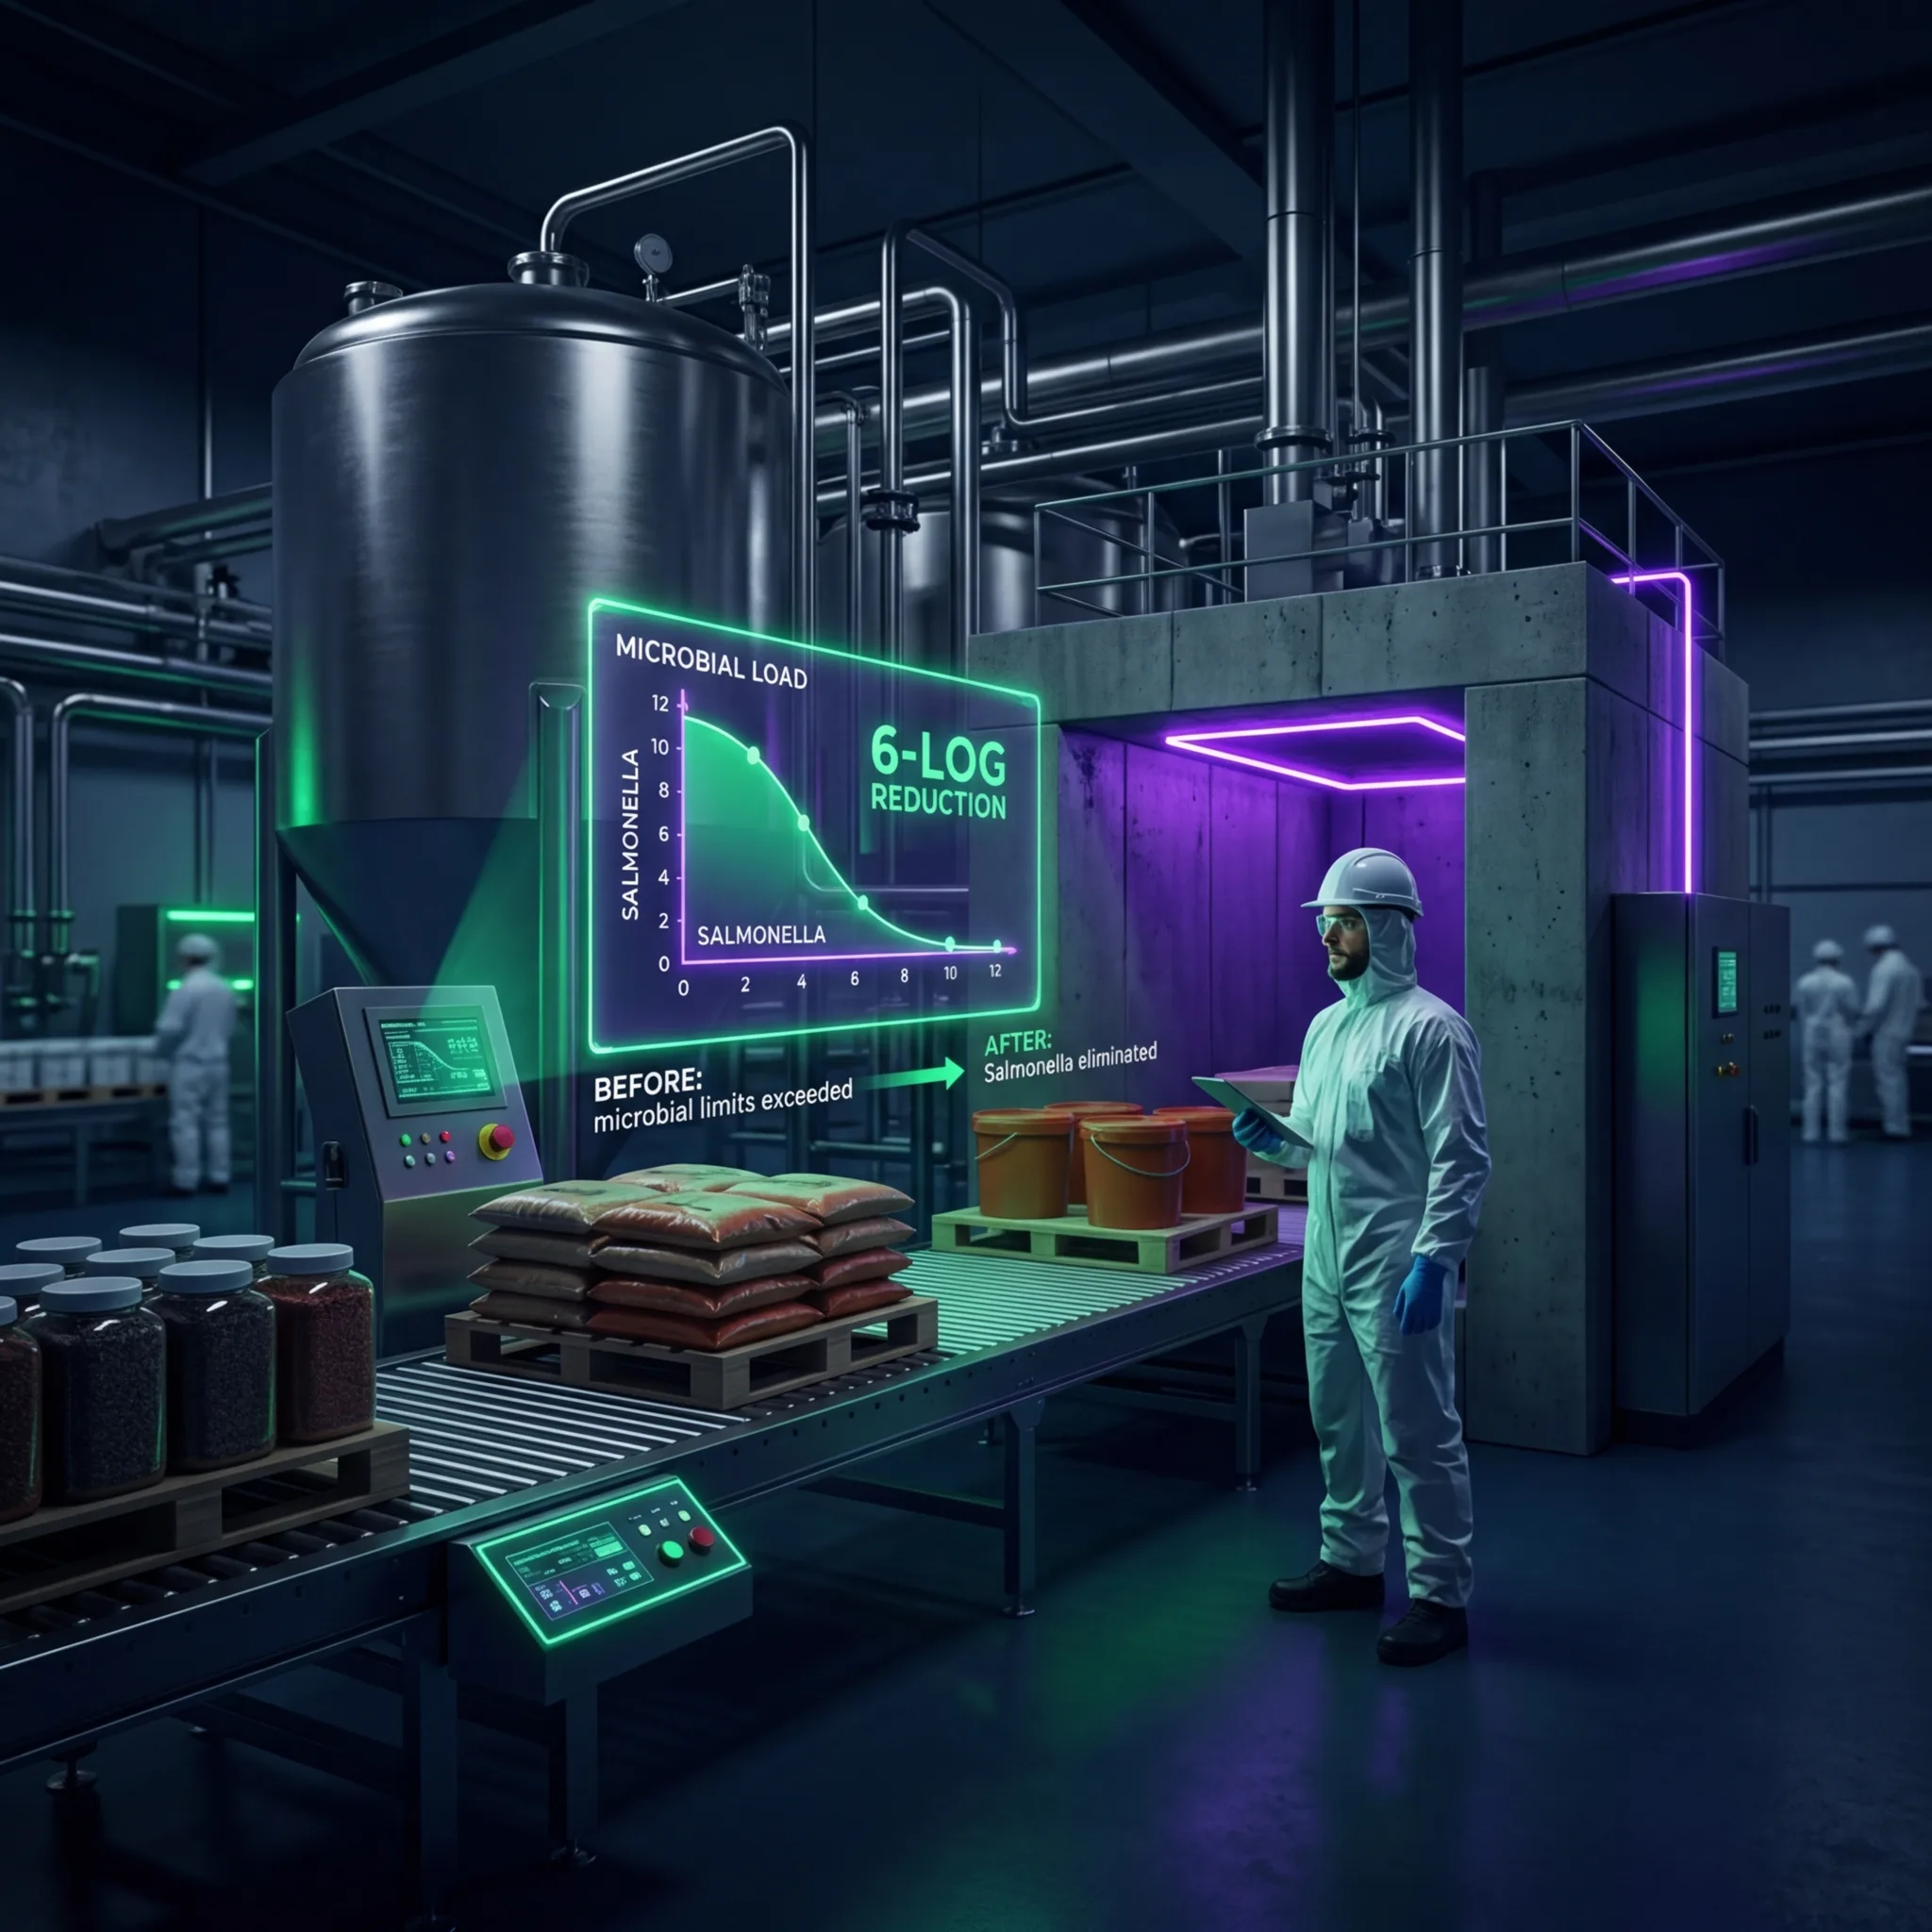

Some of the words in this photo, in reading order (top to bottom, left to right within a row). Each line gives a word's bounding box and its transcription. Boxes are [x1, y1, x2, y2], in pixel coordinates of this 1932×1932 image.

[616, 633, 745, 679] MICROBIAL
[752, 660, 808, 690] LOAD
[652, 693, 669, 712] 12
[651, 738, 670, 756] 10
[871, 724, 1007, 787] 6-LOG
[658, 781, 670, 799] 8
[871, 782, 1007, 820] REDUCTION
[621, 749, 639, 921] SALMONELLA
[658, 825, 670, 842] 6
[658, 869, 670, 886] 4
[658, 912, 670, 929] 2
[697, 924, 826, 946] SALMONELLA
[658, 955, 670, 973] 0
[943, 965, 958, 980] 10
[989, 963, 1002, 977] 12
[741, 975, 750, 992] 2
[796, 973, 807, 989] 4
[850, 971, 859, 986] 6
[900, 967, 909, 983] 8
[677, 979, 690, 996] 0
[984, 1029, 1053, 1057] AFTER:
[984, 1054, 1074, 1083] Salmonella
[594, 1067, 703, 1102] BEFORE:
[594, 1097, 693, 1133] microbial
[700, 1092, 756, 1120] limits
[761, 1077, 853, 1110] exceeded
